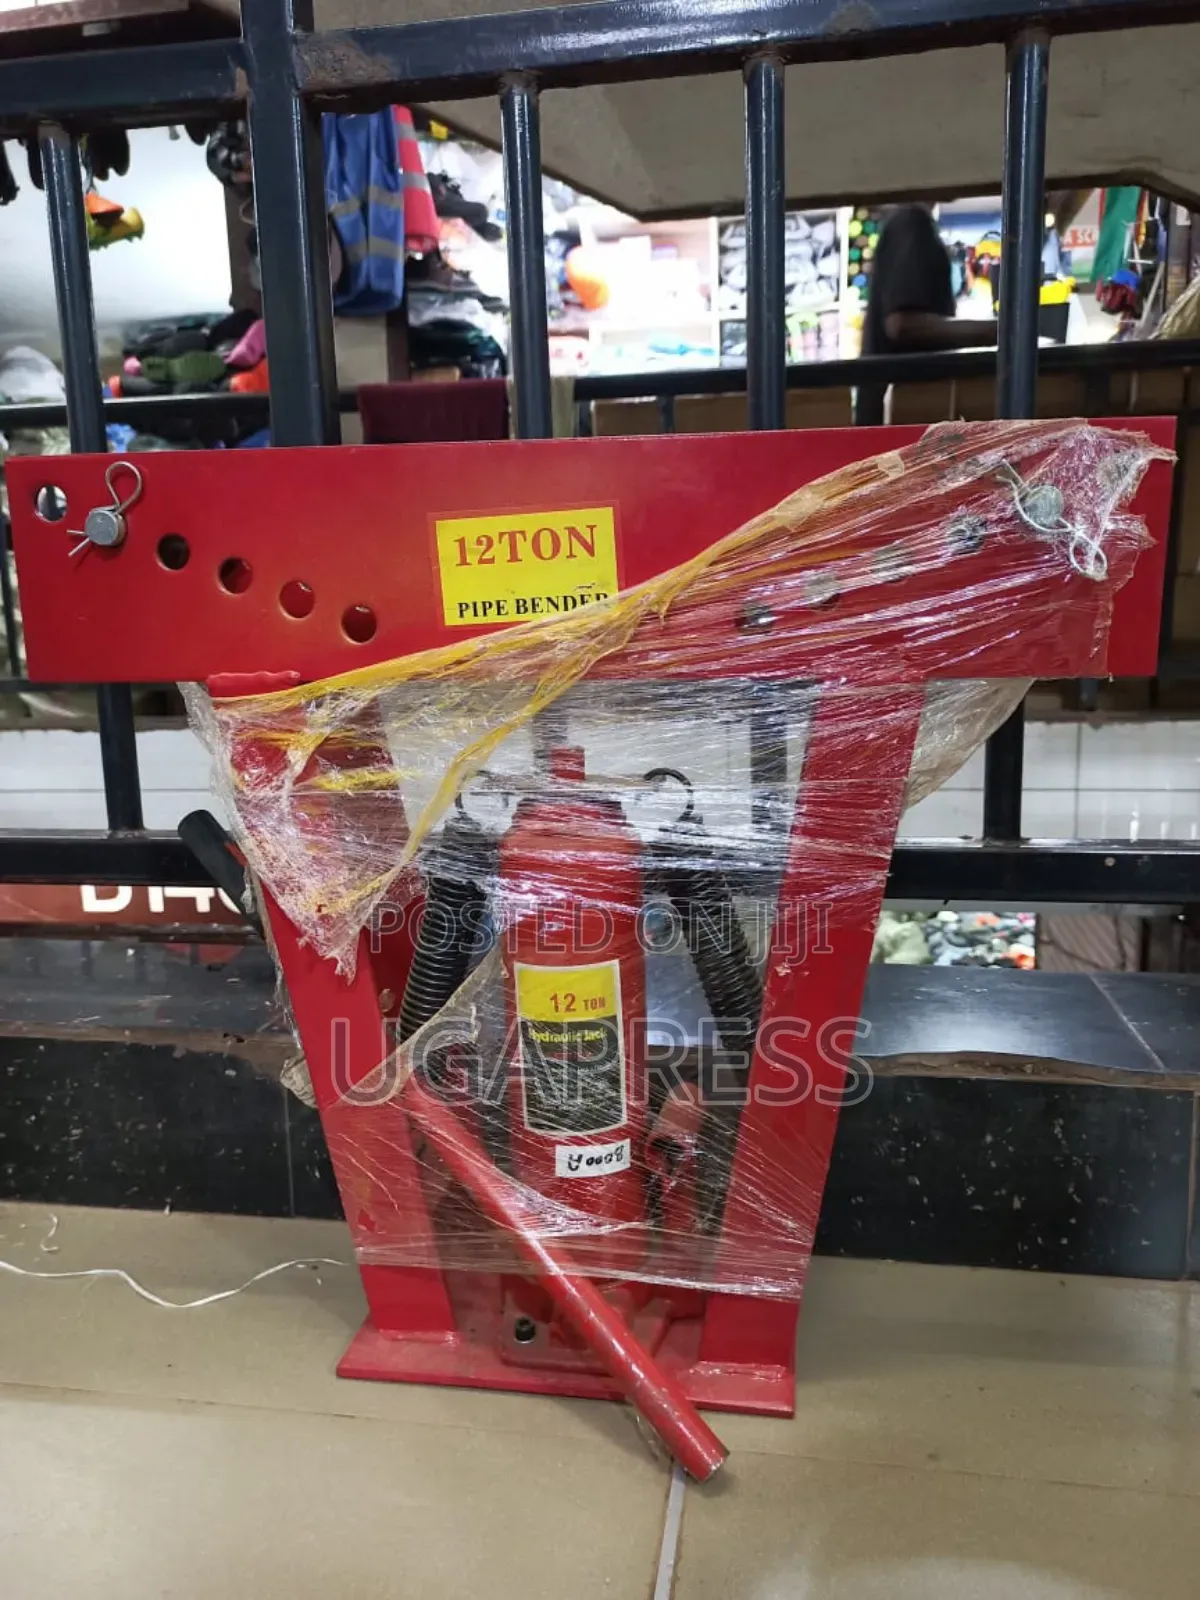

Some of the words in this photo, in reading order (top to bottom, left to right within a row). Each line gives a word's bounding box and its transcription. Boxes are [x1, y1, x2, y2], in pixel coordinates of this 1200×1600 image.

[454, 524, 597, 566] 12TON
[457, 599, 509, 618] PIPE
[550, 992, 577, 1012] 12
[583, 996, 605, 1012] TON
